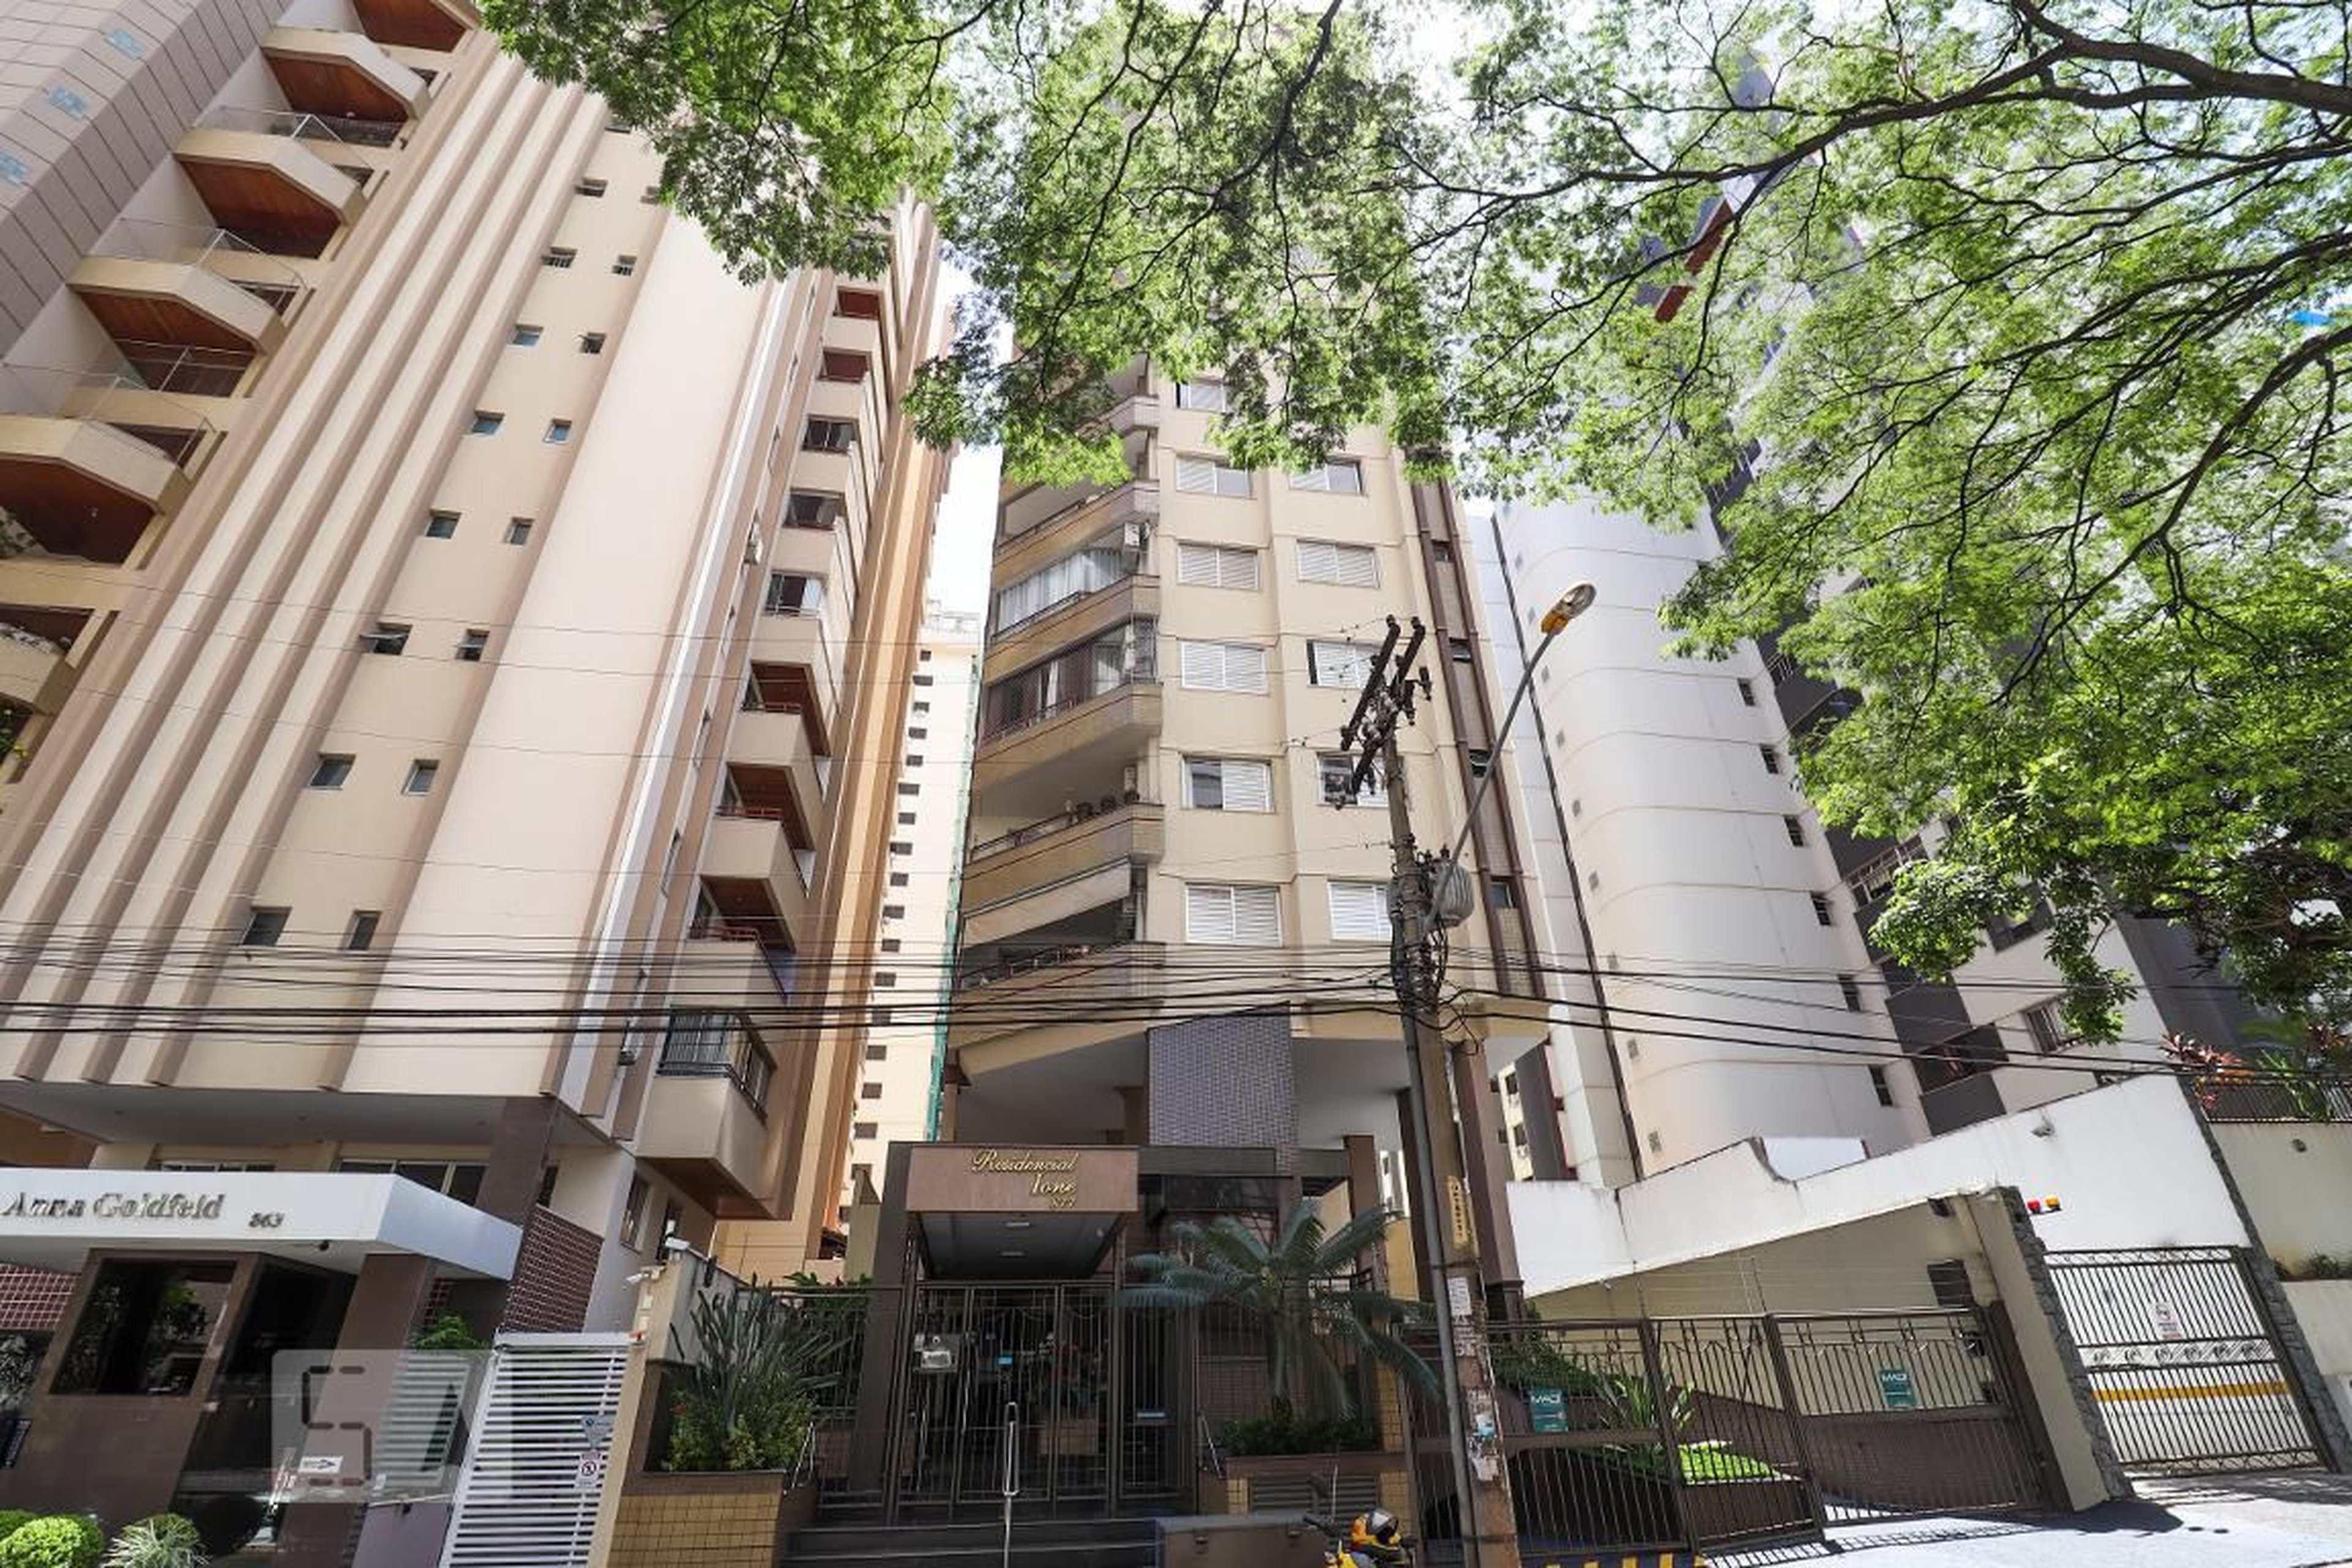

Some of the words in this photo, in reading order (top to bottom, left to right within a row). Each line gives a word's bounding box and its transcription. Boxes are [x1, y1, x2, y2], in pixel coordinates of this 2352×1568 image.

[971, 1149, 1079, 1172] Residencial
[2, 1192, 86, 1218] Anna
[94, 1193, 225, 1219] Goldfeld
